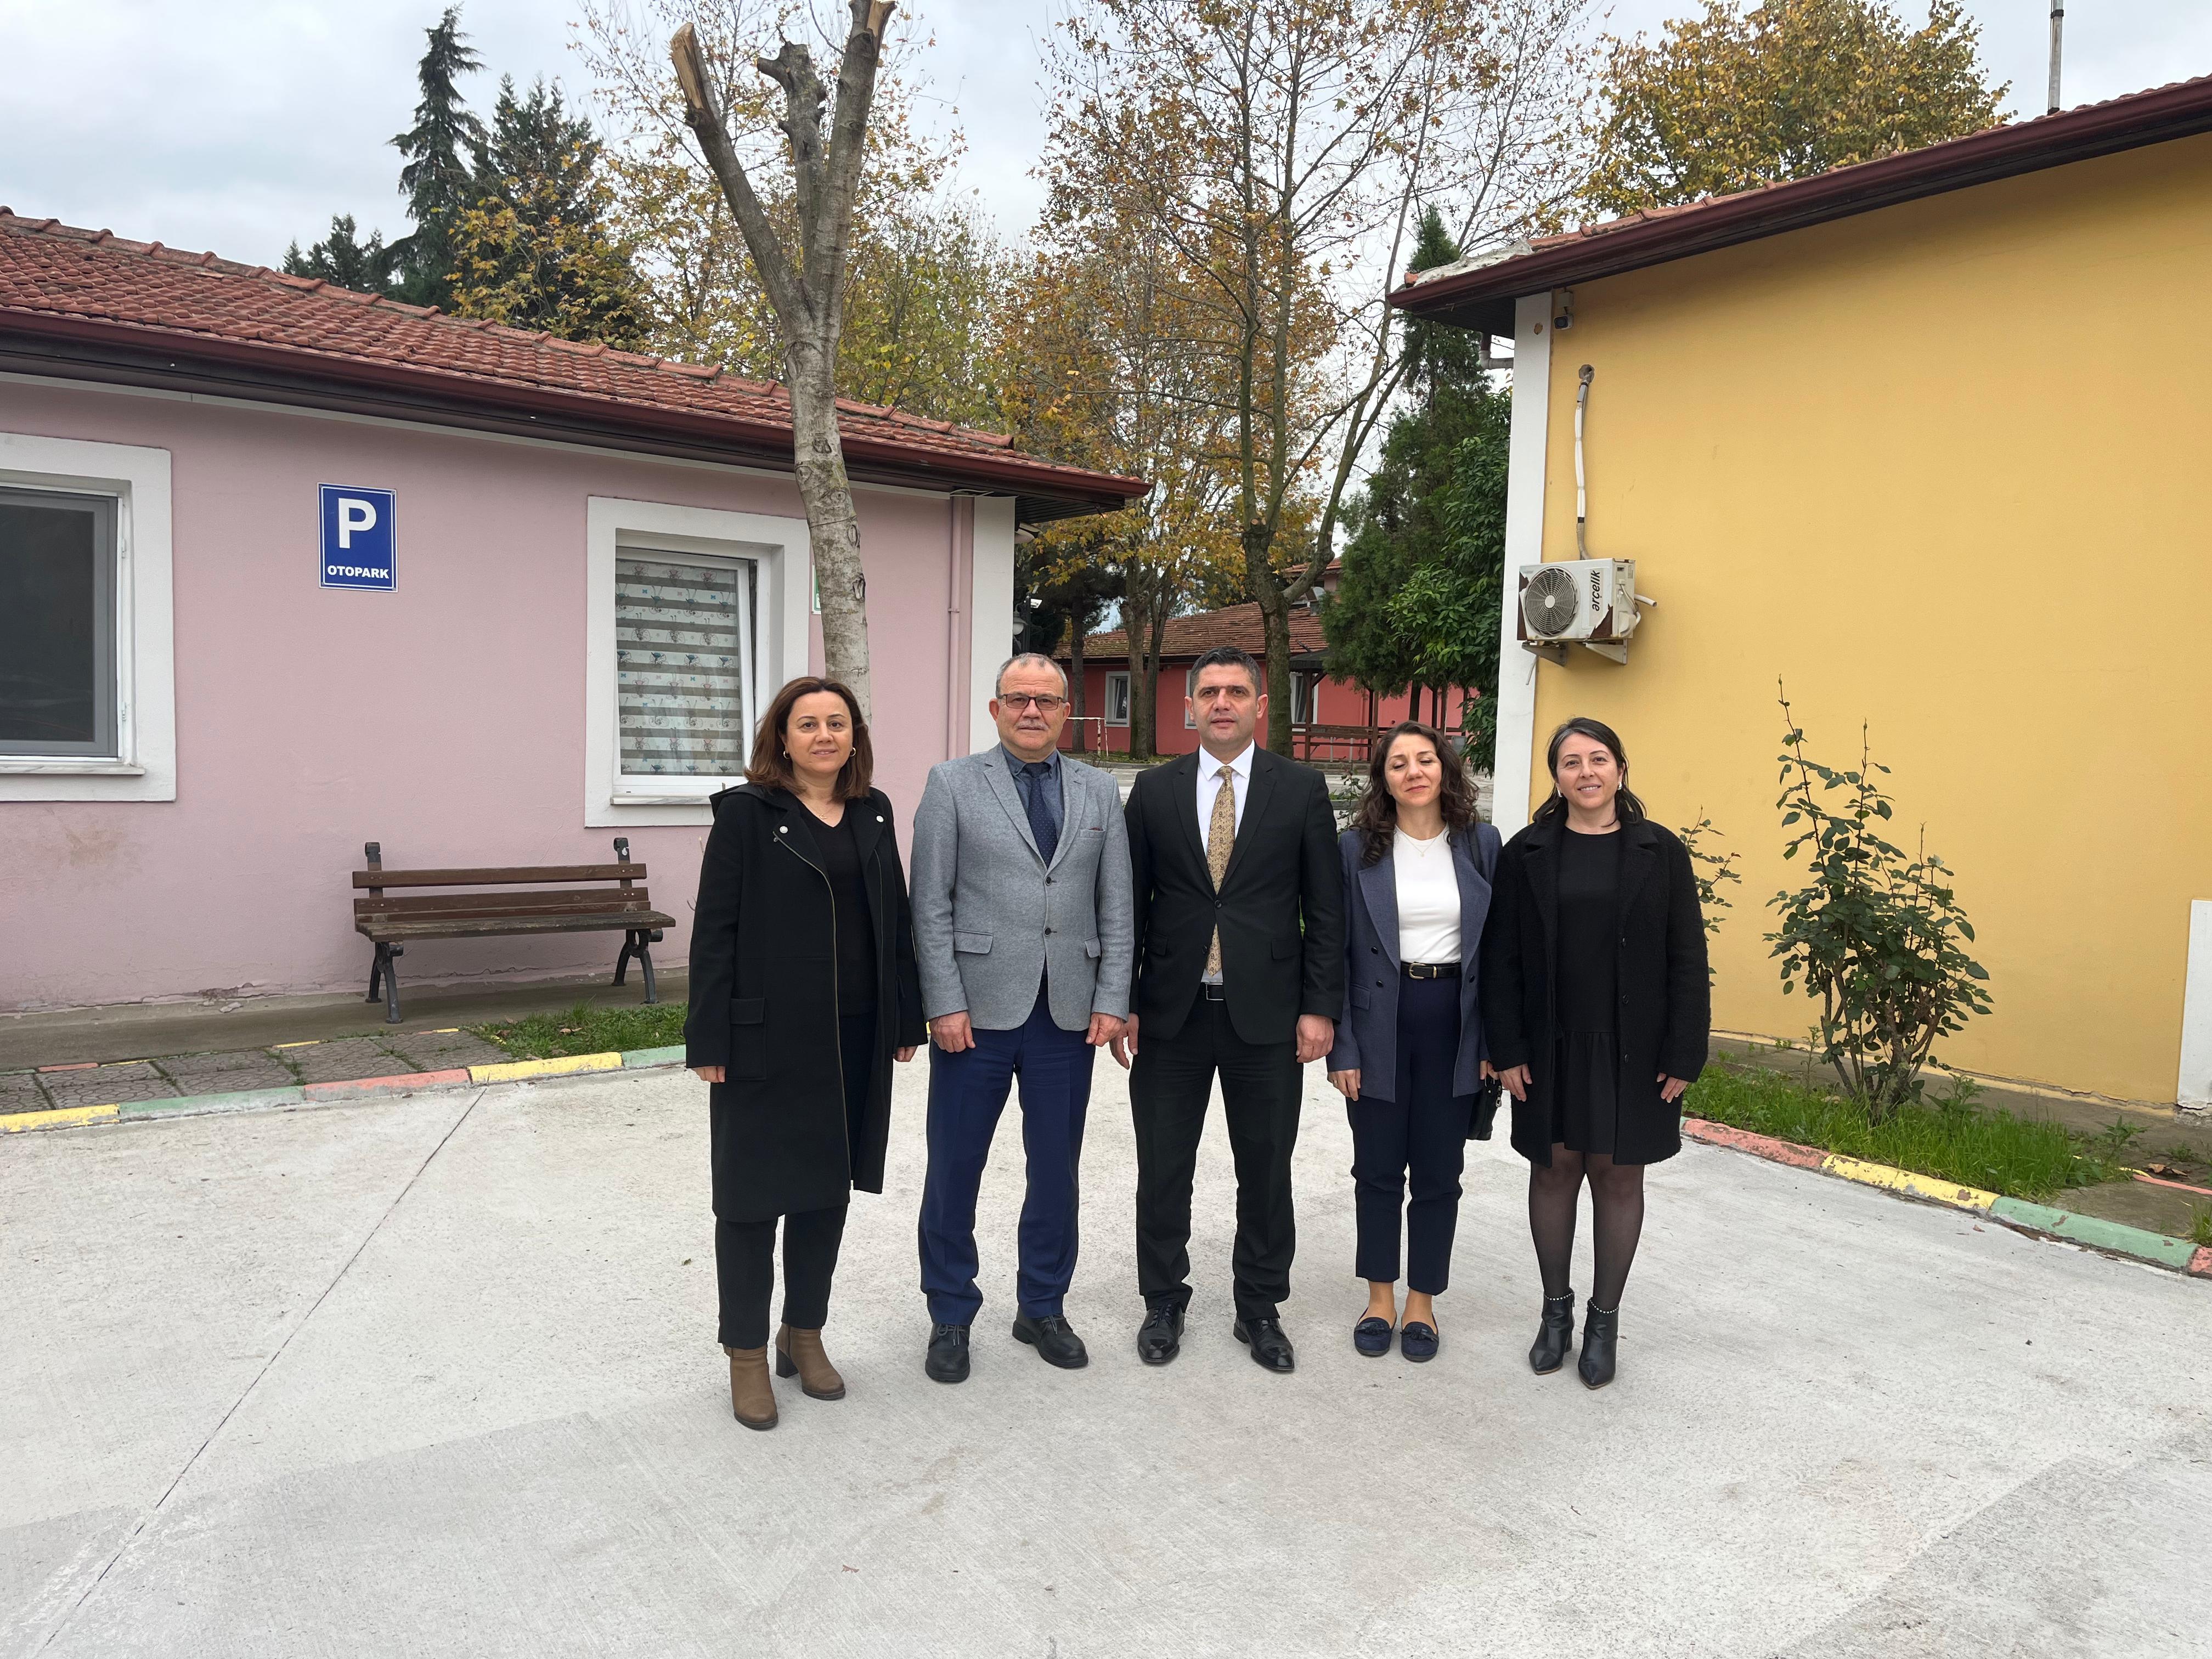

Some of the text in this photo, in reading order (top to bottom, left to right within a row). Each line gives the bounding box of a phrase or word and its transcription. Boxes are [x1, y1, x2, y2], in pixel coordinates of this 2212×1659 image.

[338, 498, 376, 549] P
[327, 565, 390, 579] OTOPARK
[1591, 570, 1602, 612] arçelik
